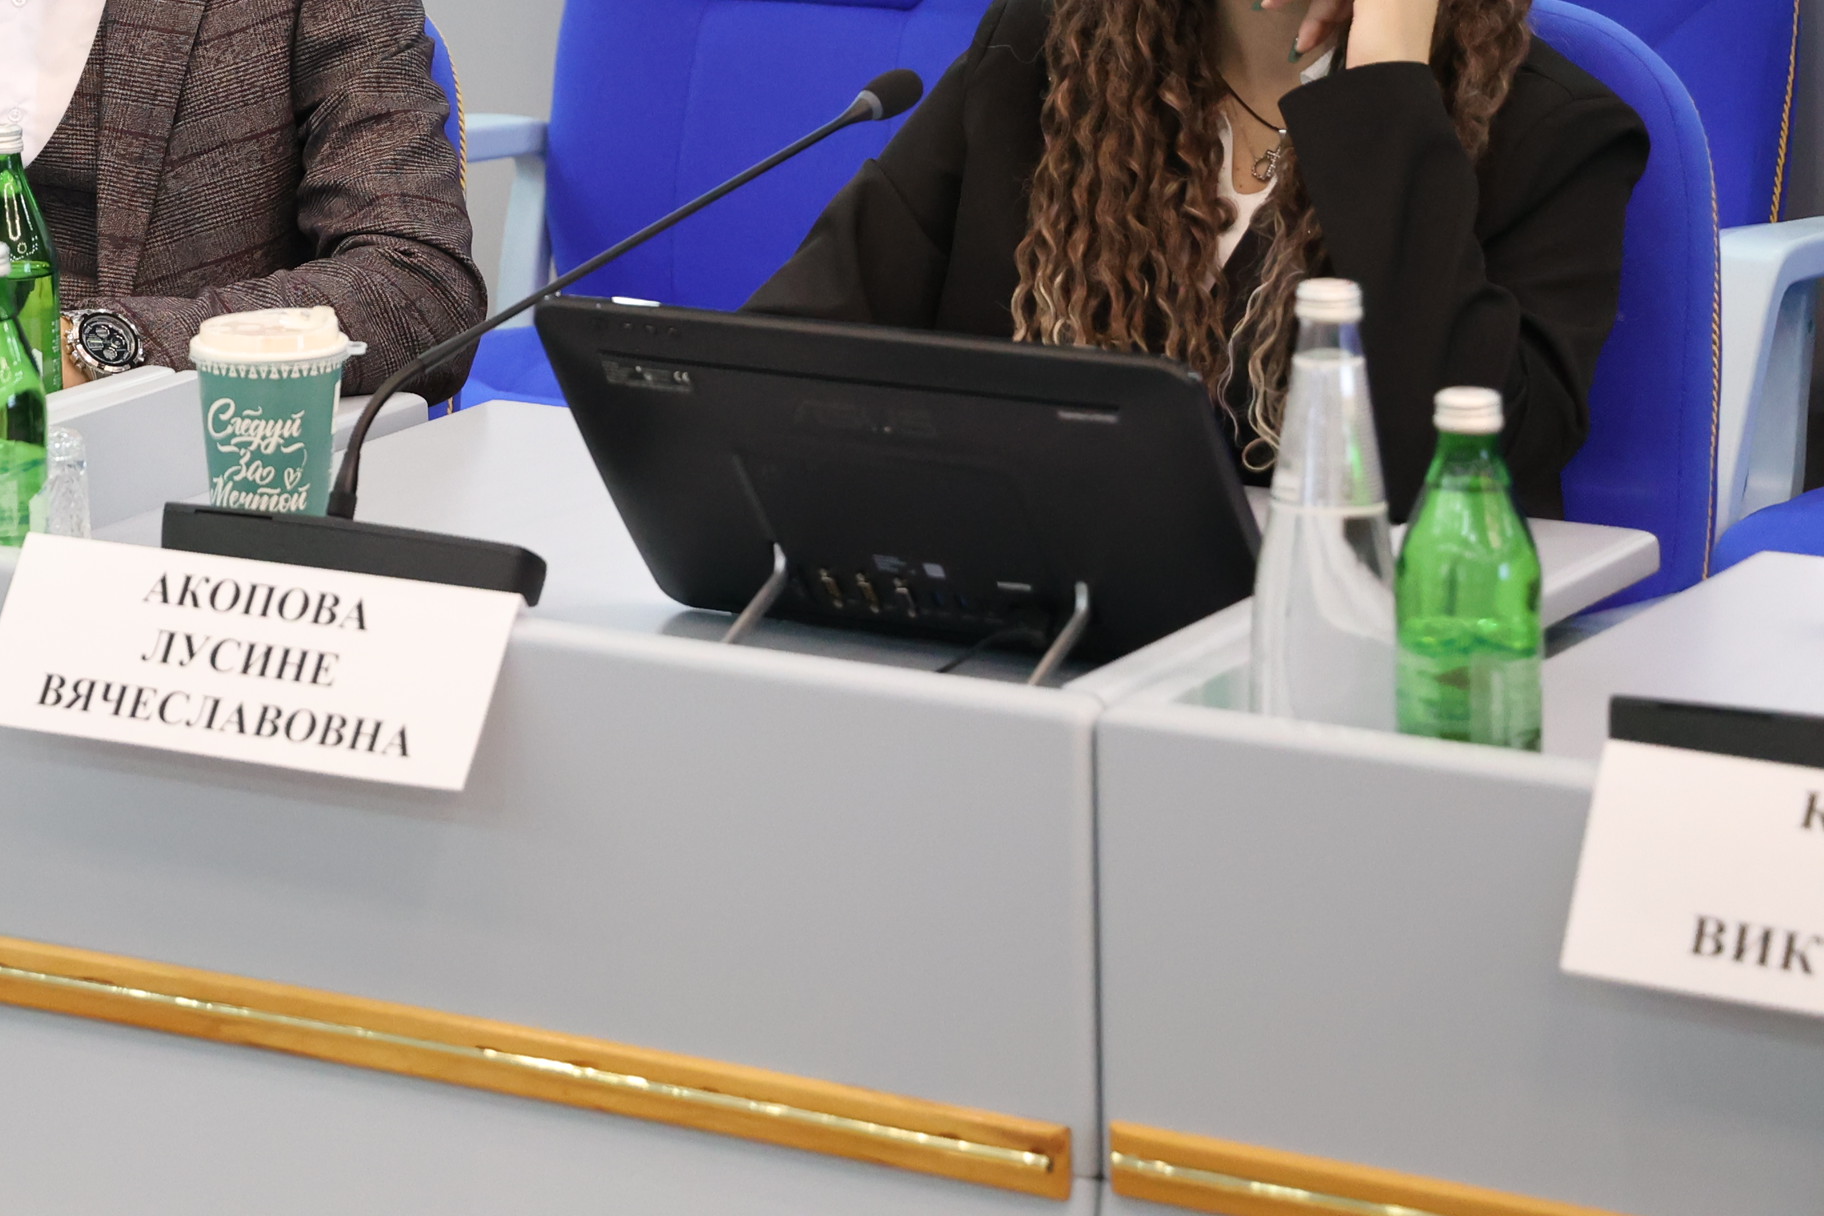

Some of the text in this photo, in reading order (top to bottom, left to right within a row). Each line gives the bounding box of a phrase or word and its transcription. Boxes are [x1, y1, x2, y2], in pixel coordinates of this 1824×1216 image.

[207, 397, 305, 454] Следуй
[210, 474, 311, 513] Мечтой
[223, 448, 276, 485] За
[143, 572, 369, 632] АКОПОВА
[141, 630, 341, 690] ЛУСИНЕ
[36, 672, 412, 759] ВЯЧЕСЛАВОВНА
[1690, 913, 1824, 975] ВИК
